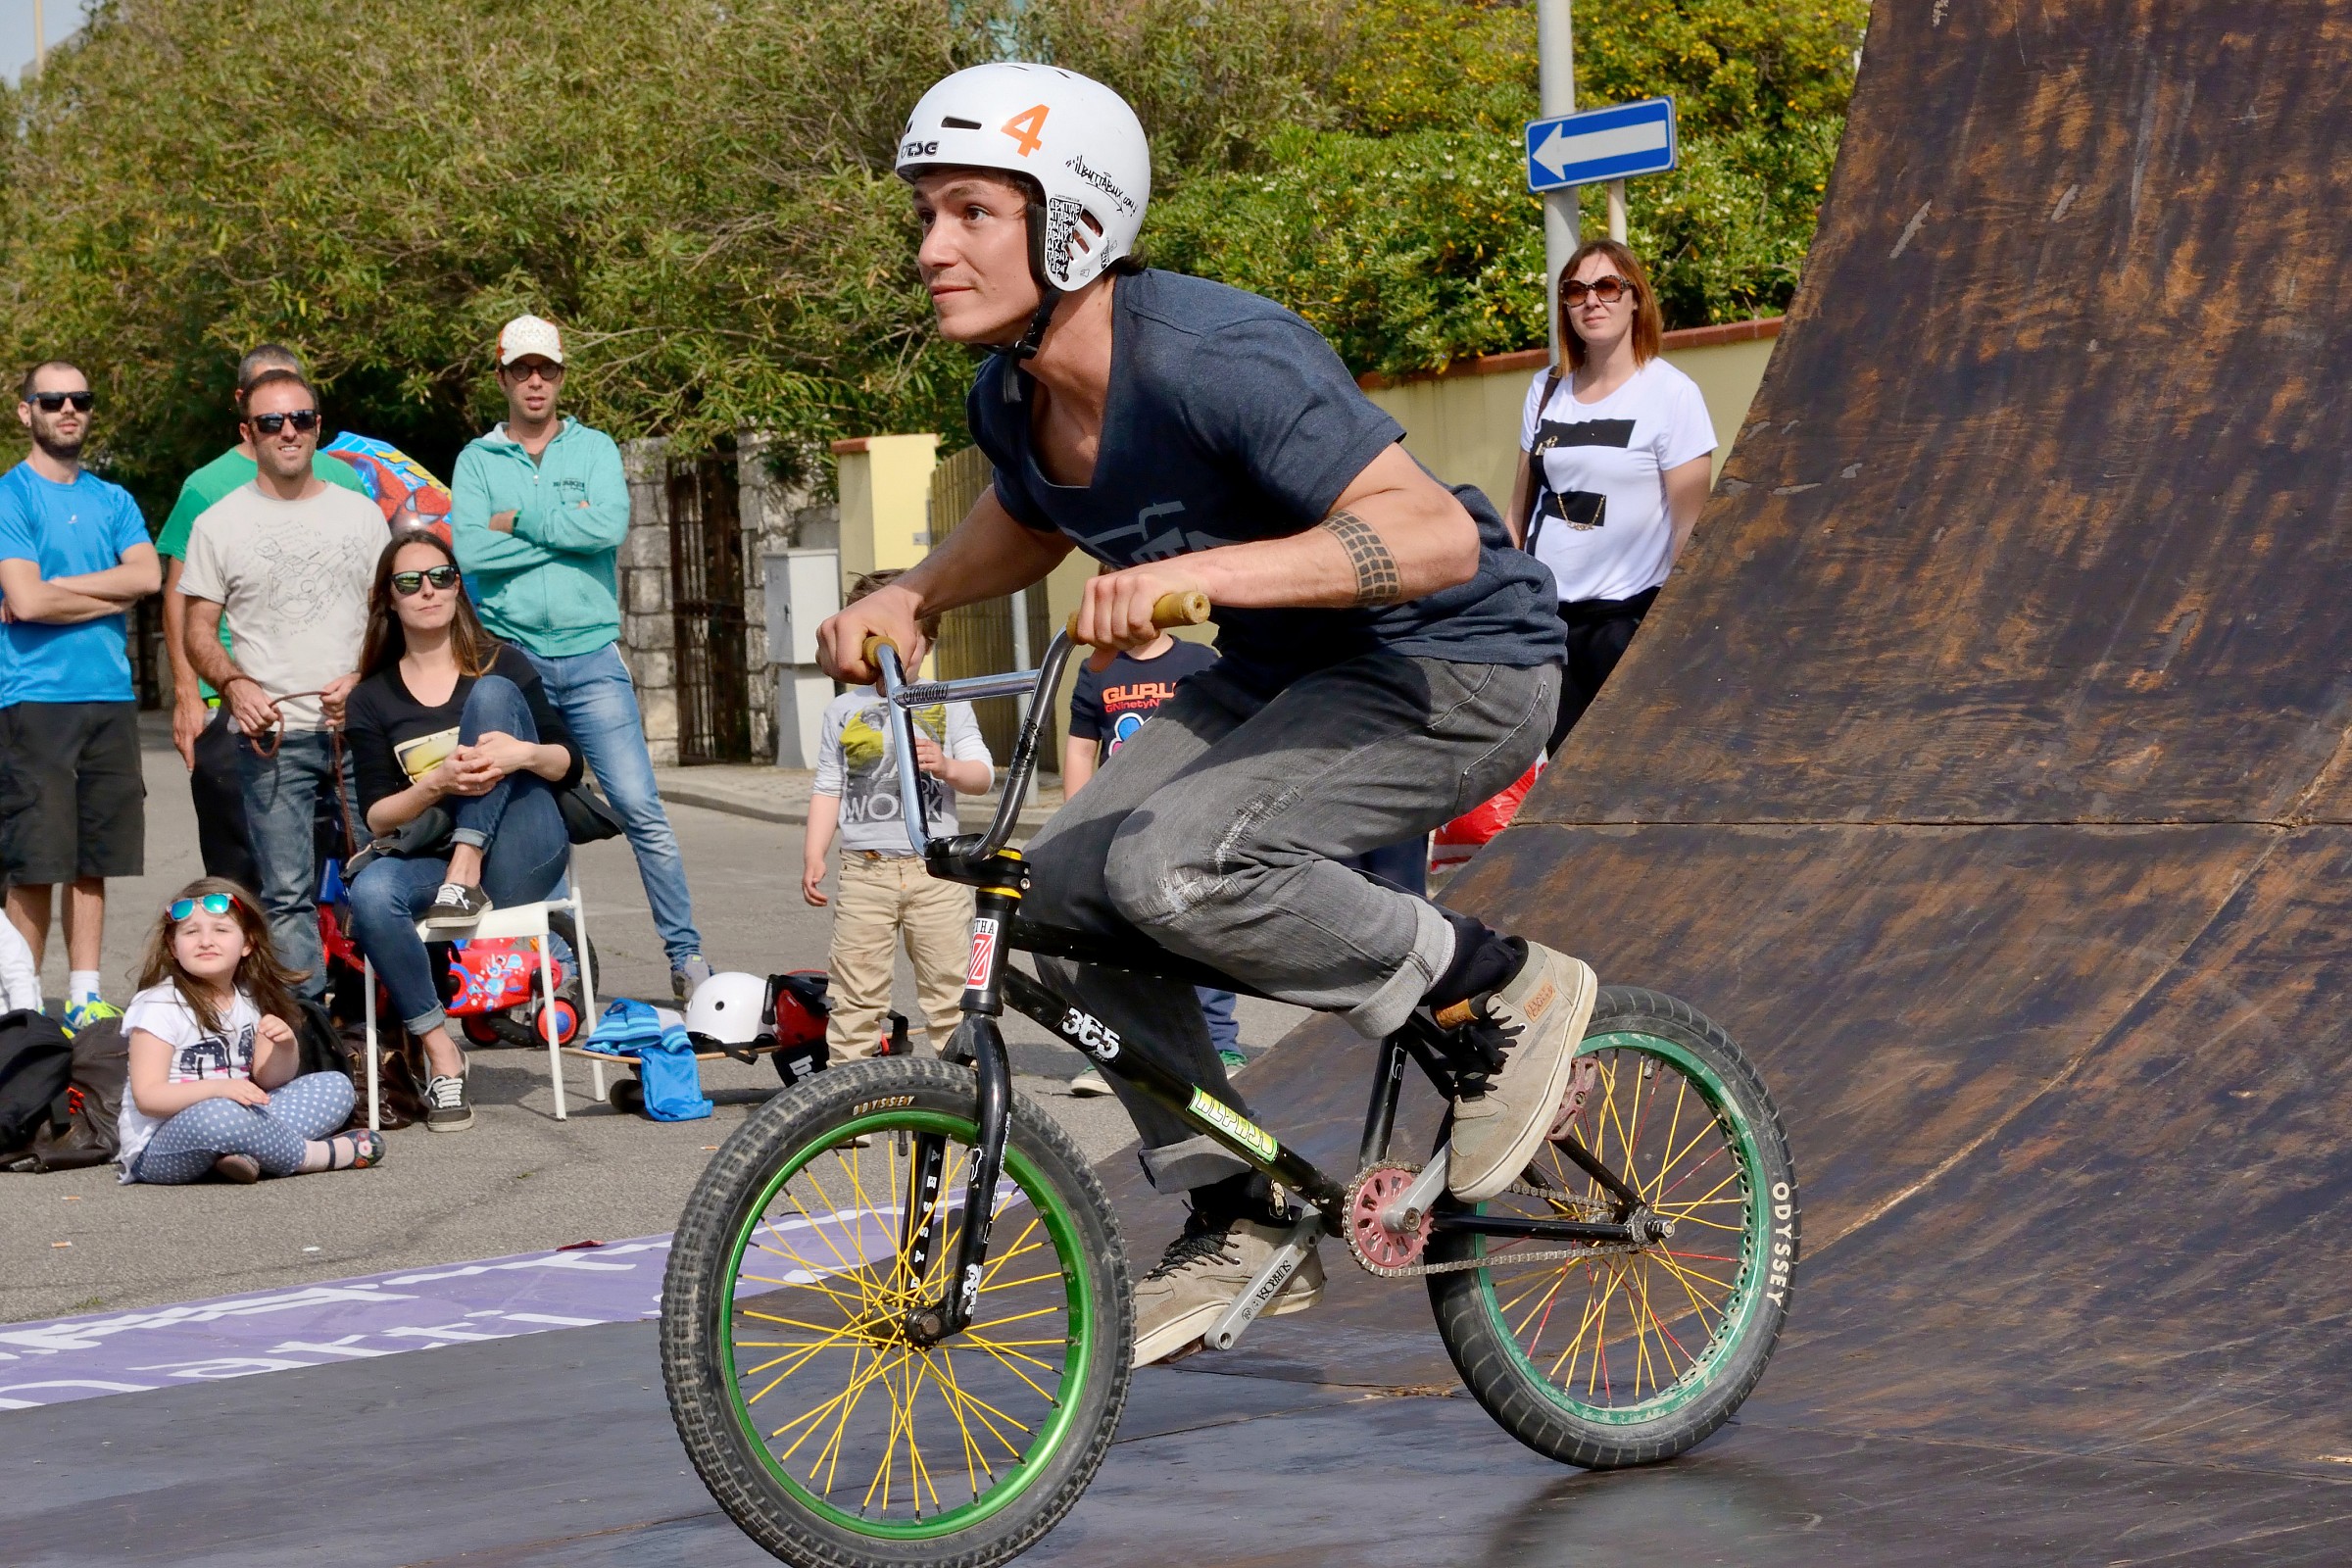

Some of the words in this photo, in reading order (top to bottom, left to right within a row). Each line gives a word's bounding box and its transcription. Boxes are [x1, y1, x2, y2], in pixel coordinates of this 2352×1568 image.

[1000, 103, 1051, 158] 4
[847, 793, 943, 823] WOK
[853, 1095, 915, 1116] ODYSSEY
[1767, 1182, 1793, 1308] ODYSSEY
[1256, 1259, 1293, 1301] SUBROSA
